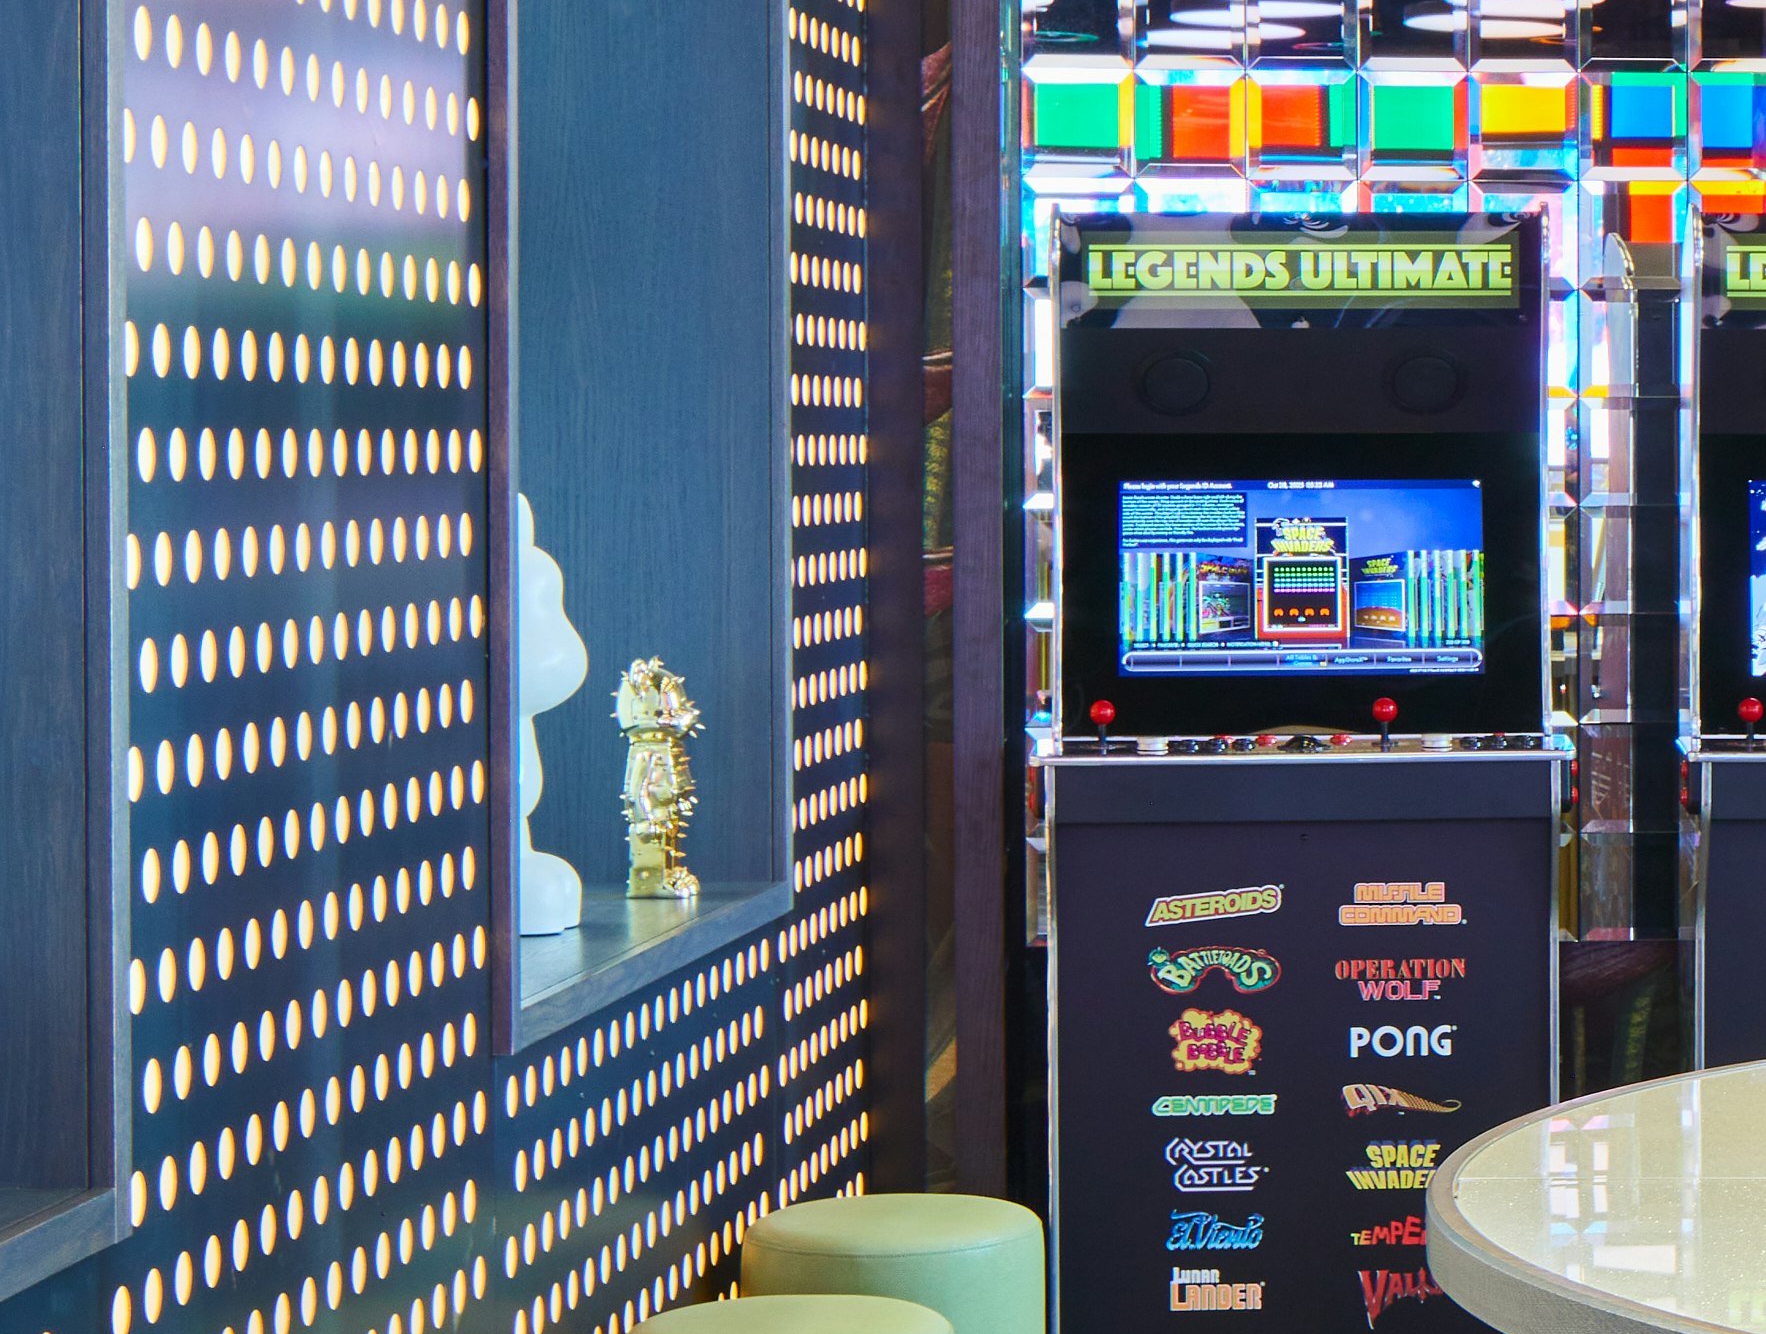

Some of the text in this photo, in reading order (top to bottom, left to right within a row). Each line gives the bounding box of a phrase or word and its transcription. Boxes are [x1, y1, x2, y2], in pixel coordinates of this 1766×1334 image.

[1088, 251, 1512, 290] LEGENDS ULTIMATE
[1283, 525, 1325, 540] SPACE
[1271, 539, 1335, 553] INVADERS
[1151, 888, 1278, 922] ASTEROIDS
[1356, 884, 1443, 902] MISSILE
[1341, 906, 1460, 924] COMMAND
[1157, 949, 1273, 988] BATTLETOADS
[1335, 958, 1467, 980] OPERATION
[1358, 980, 1441, 1001] WOLF
[1178, 1021, 1252, 1047] BUBBLE
[1349, 1024, 1452, 1058] PONG
[1187, 1042, 1245, 1065] BOBBLE
[1152, 1095, 1275, 1116] CENTIPEDE
[1165, 1137, 1253, 1165] CRYSTAL
[1365, 1142, 1441, 1168] SPACE
[1173, 1164, 1261, 1192] CASTLES
[1350, 1215, 1426, 1246] TEMPE
[1172, 1267, 1220, 1283] LUNAR
[1170, 1282, 1263, 1311] LANDER
